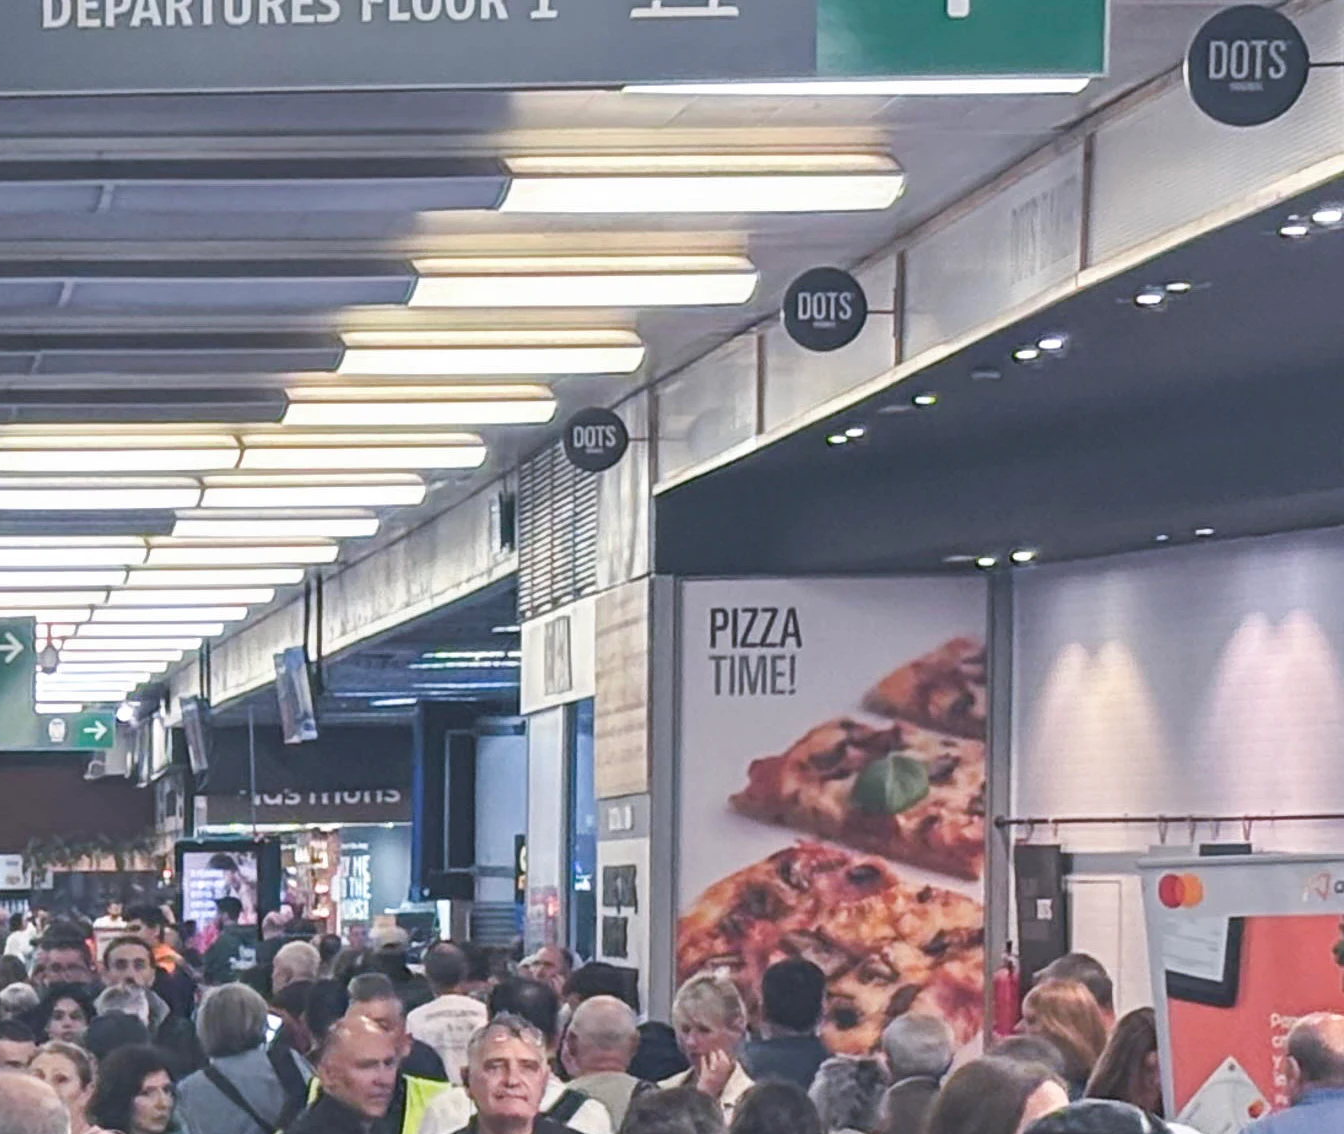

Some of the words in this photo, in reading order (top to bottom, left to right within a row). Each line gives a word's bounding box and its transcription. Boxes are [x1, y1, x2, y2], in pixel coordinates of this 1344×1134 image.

[1208, 40, 1288, 80] DOTS
[797, 291, 853, 321] DOTS
[573, 425, 616, 448] DOTS
[709, 606, 803, 649] PIZZA
[708, 652, 799, 697] TIME!
